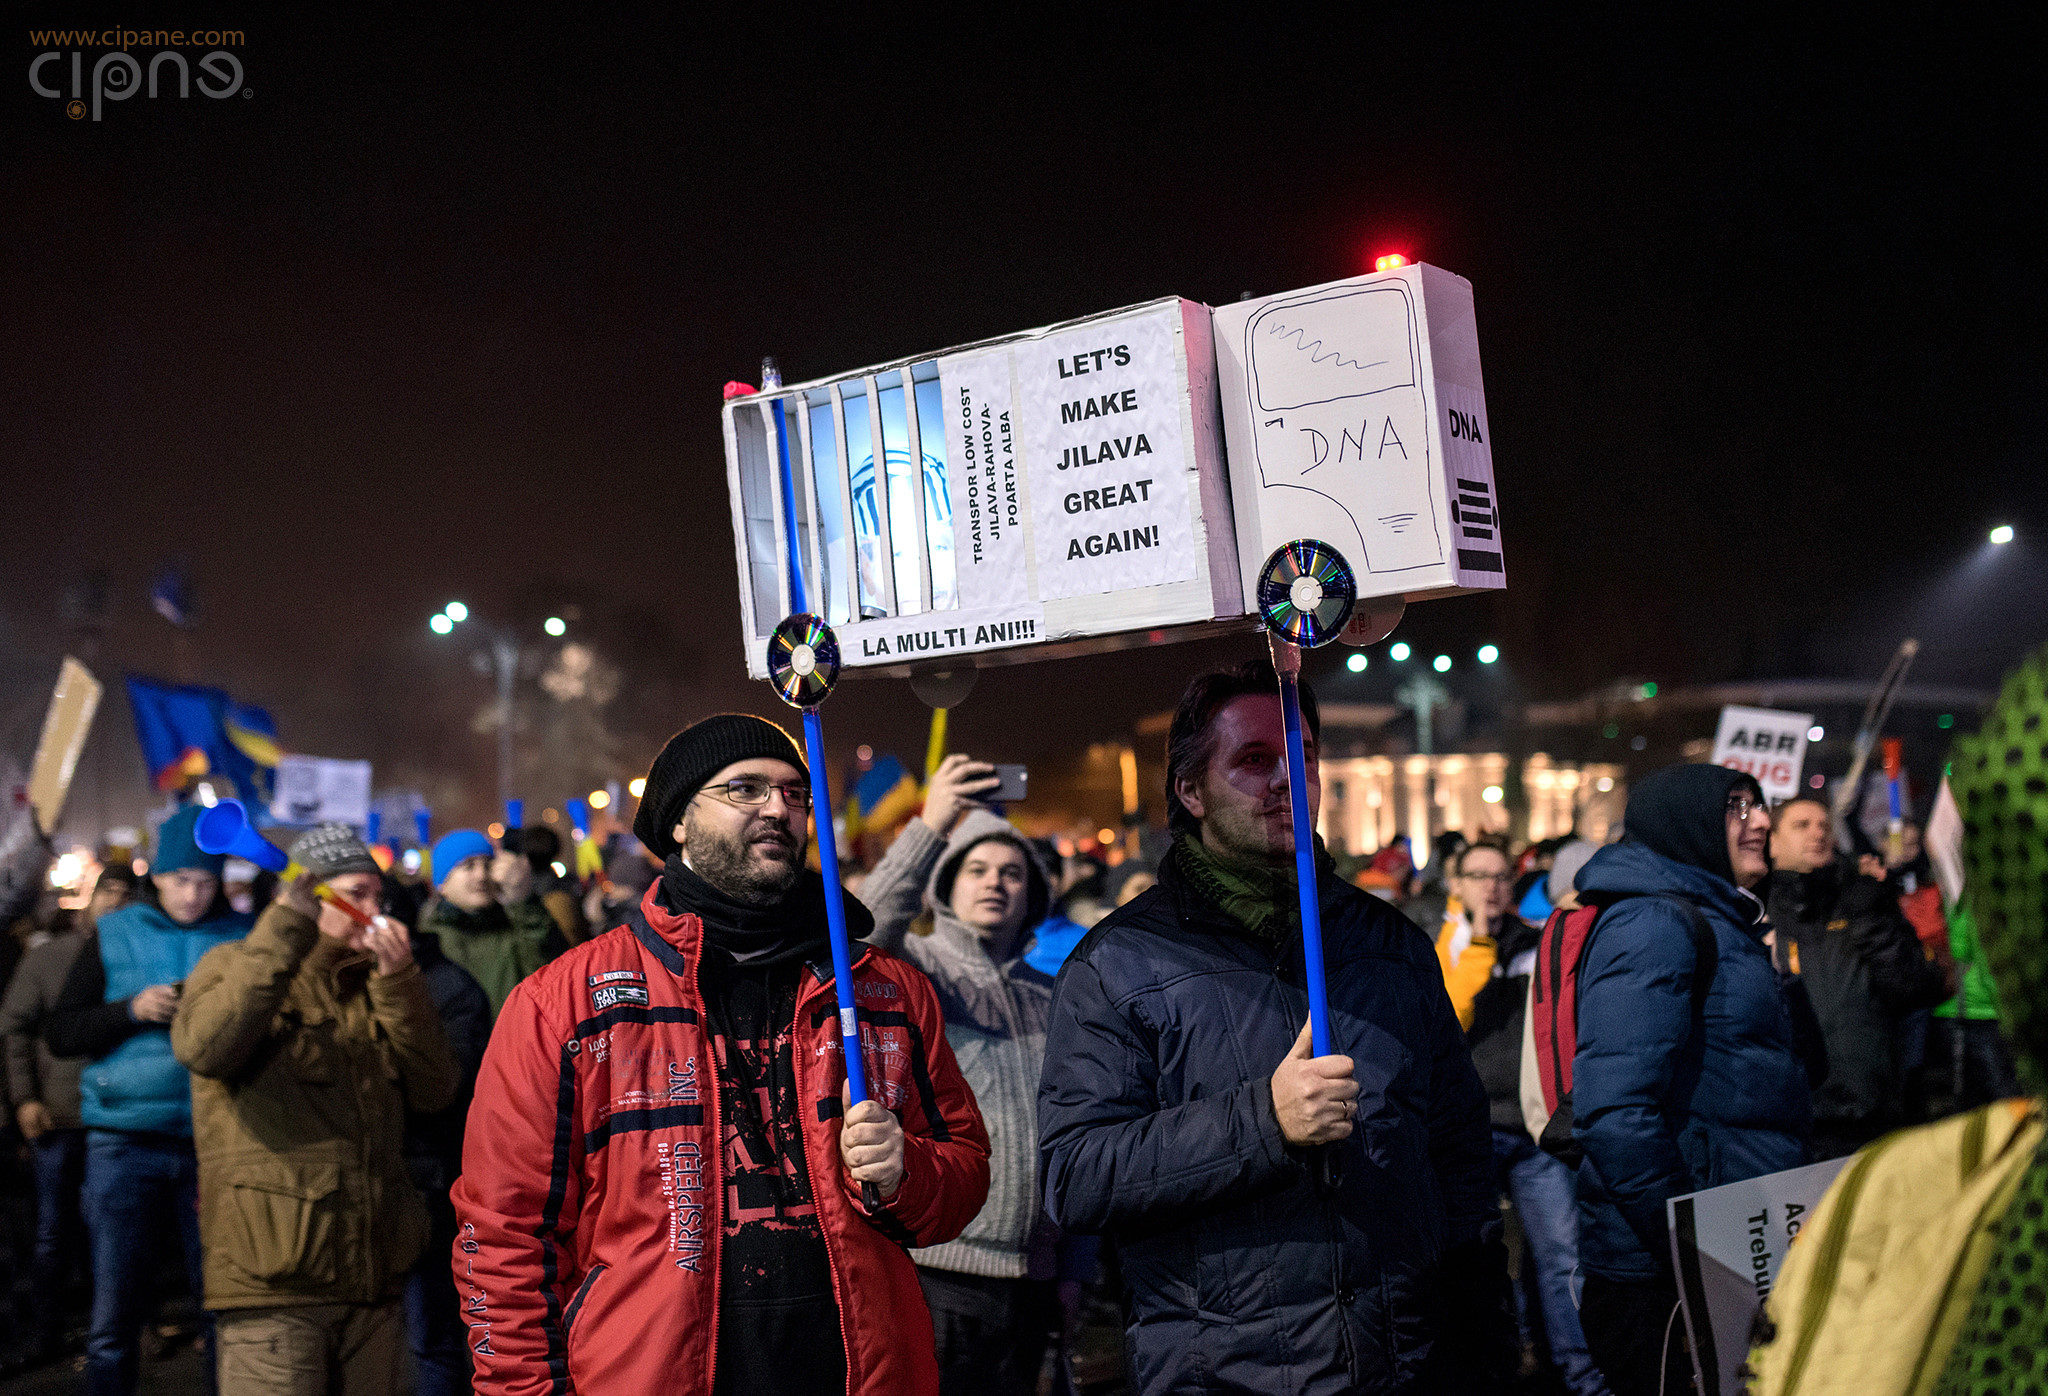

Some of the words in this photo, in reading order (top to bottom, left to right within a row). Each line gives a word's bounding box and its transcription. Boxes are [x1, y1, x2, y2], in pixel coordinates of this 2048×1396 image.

[960, 386, 973, 430] COST
[1060, 388, 1139, 425] MAKE
[1448, 408, 1484, 444] DNA
[963, 434, 978, 471] LOW
[999, 410, 1014, 455] ALBA
[1056, 433, 1154, 471] JILAVA
[1300, 415, 1409, 476] DNA
[1003, 459, 1019, 527] POARTA
[1063, 478, 1154, 515] GREAT
[966, 474, 984, 565] TRANSPOR
[1066, 524, 1161, 561] AGAIN!
[862, 637, 891, 658] LA
[896, 627, 967, 654] MULTI
[974, 619, 1036, 645] ANI!!!
[668, 1056, 699, 1101] INC.
[674, 1141, 704, 1274] AIRSPEED
